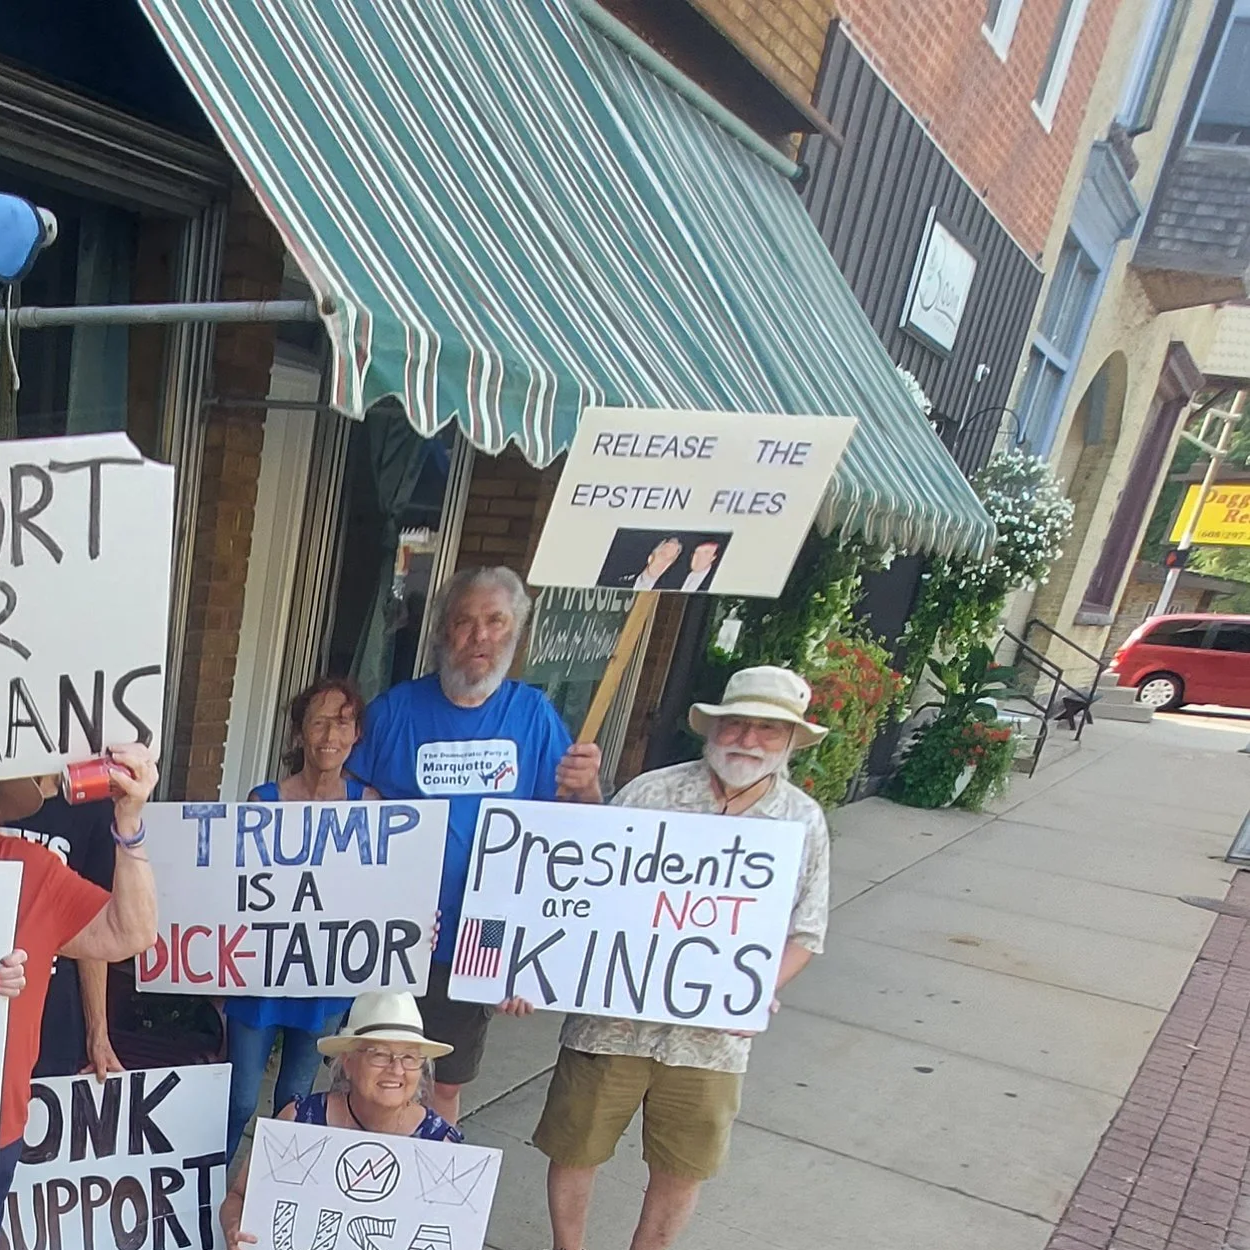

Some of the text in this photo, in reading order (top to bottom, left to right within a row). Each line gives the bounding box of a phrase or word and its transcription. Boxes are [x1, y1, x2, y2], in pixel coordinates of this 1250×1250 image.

[592, 432, 812, 466] RELEASE THE
[570, 483, 787, 516] EPSTEIN FILES
[423, 775, 470, 787] County
[182, 804, 421, 868] TRUMP
[473, 807, 776, 895] Presidents
[236, 870, 324, 912] IS A
[541, 890, 758, 936] are NOT
[139, 919, 422, 988] DICK-TATOR
[505, 926, 773, 1020] KINGS
